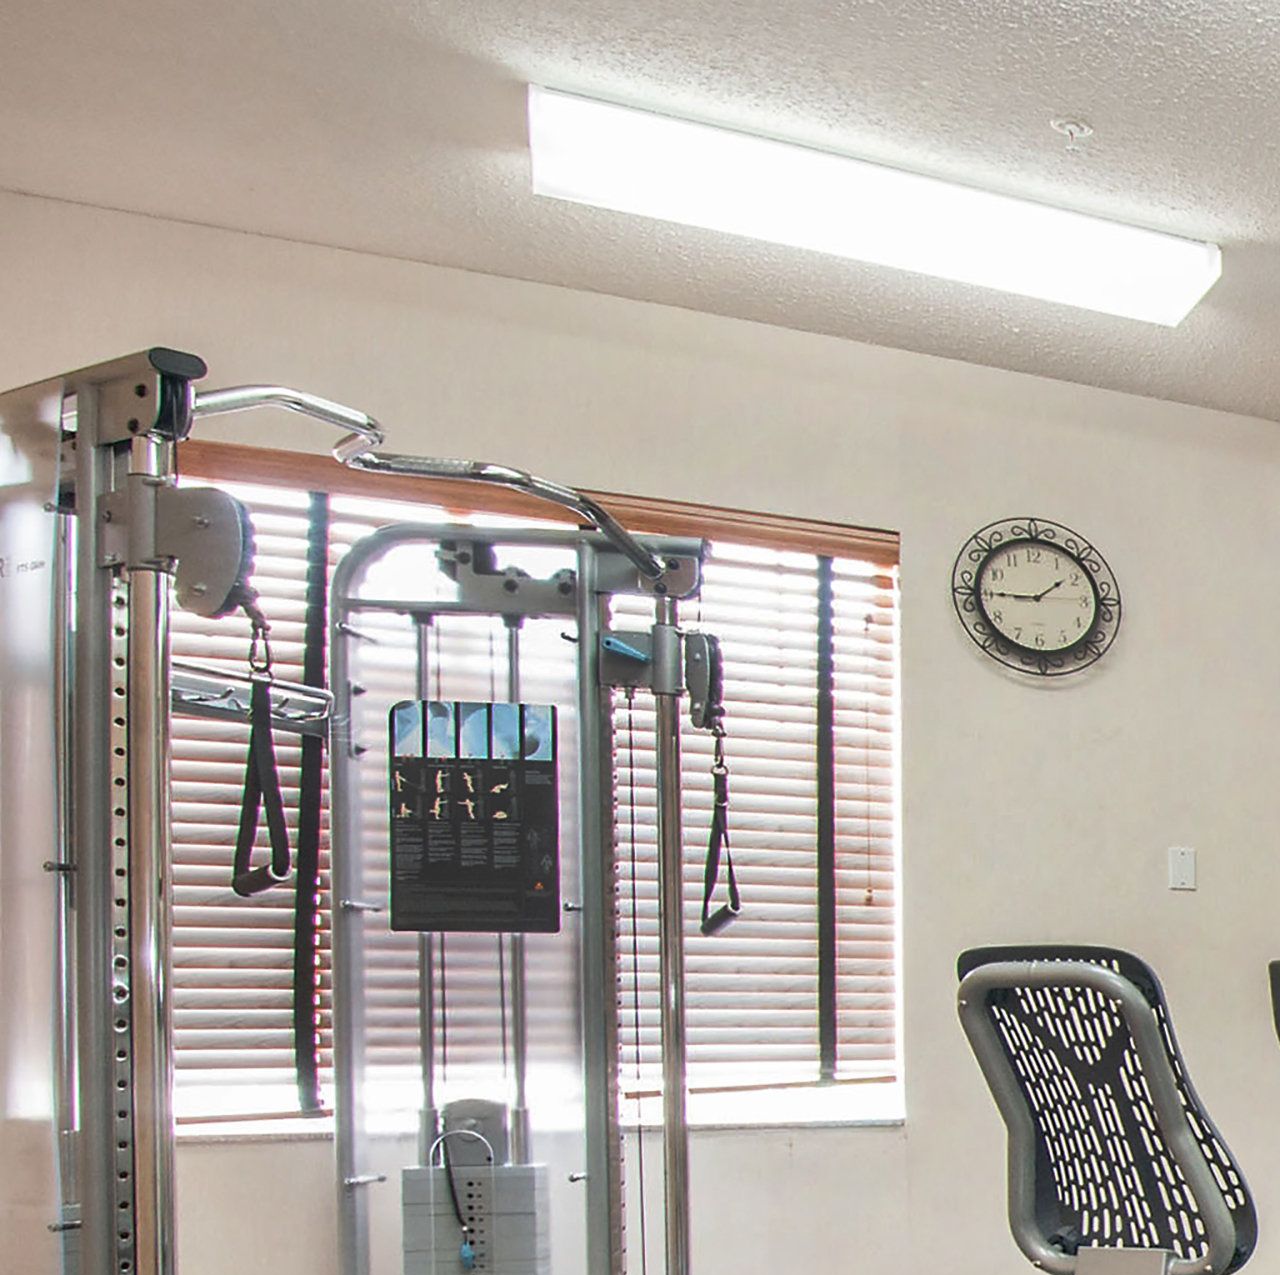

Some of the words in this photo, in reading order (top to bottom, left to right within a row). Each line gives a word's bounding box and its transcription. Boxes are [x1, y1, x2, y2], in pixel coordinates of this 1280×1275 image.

[1006, 554, 1018, 568] 11
[1026, 550, 1041, 564] 12
[1053, 557, 1060, 571] 1
[1069, 573, 1079, 587] 2
[1079, 595, 1089, 608] 3
[993, 610, 1003, 624] 8
[1014, 626, 1023, 640] 7
[1035, 633, 1045, 647] 6
